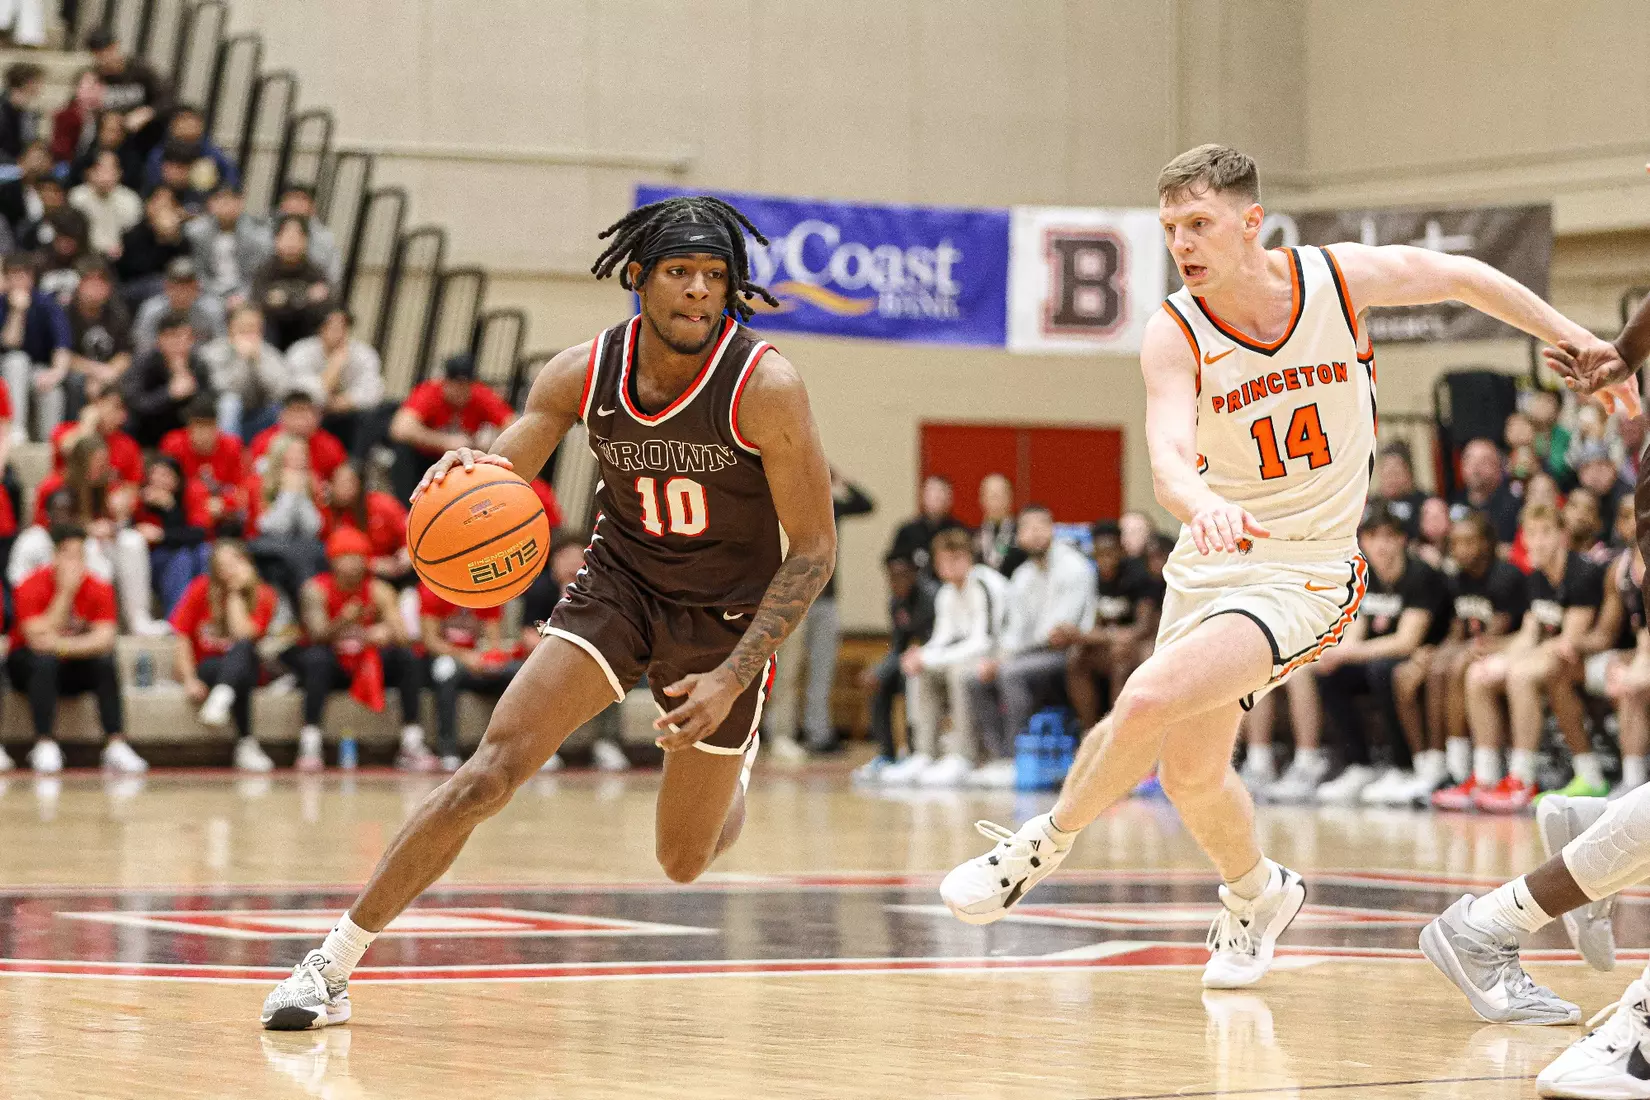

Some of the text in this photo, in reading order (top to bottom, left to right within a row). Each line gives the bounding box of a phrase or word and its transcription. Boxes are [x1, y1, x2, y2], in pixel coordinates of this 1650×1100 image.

[744, 218, 963, 290] yCoast
[1041, 227, 1131, 338] B
[1211, 361, 1348, 414] PRINCETON
[1250, 402, 1332, 480] 14
[634, 476, 710, 537] 10
[468, 537, 539, 586] ELITE
